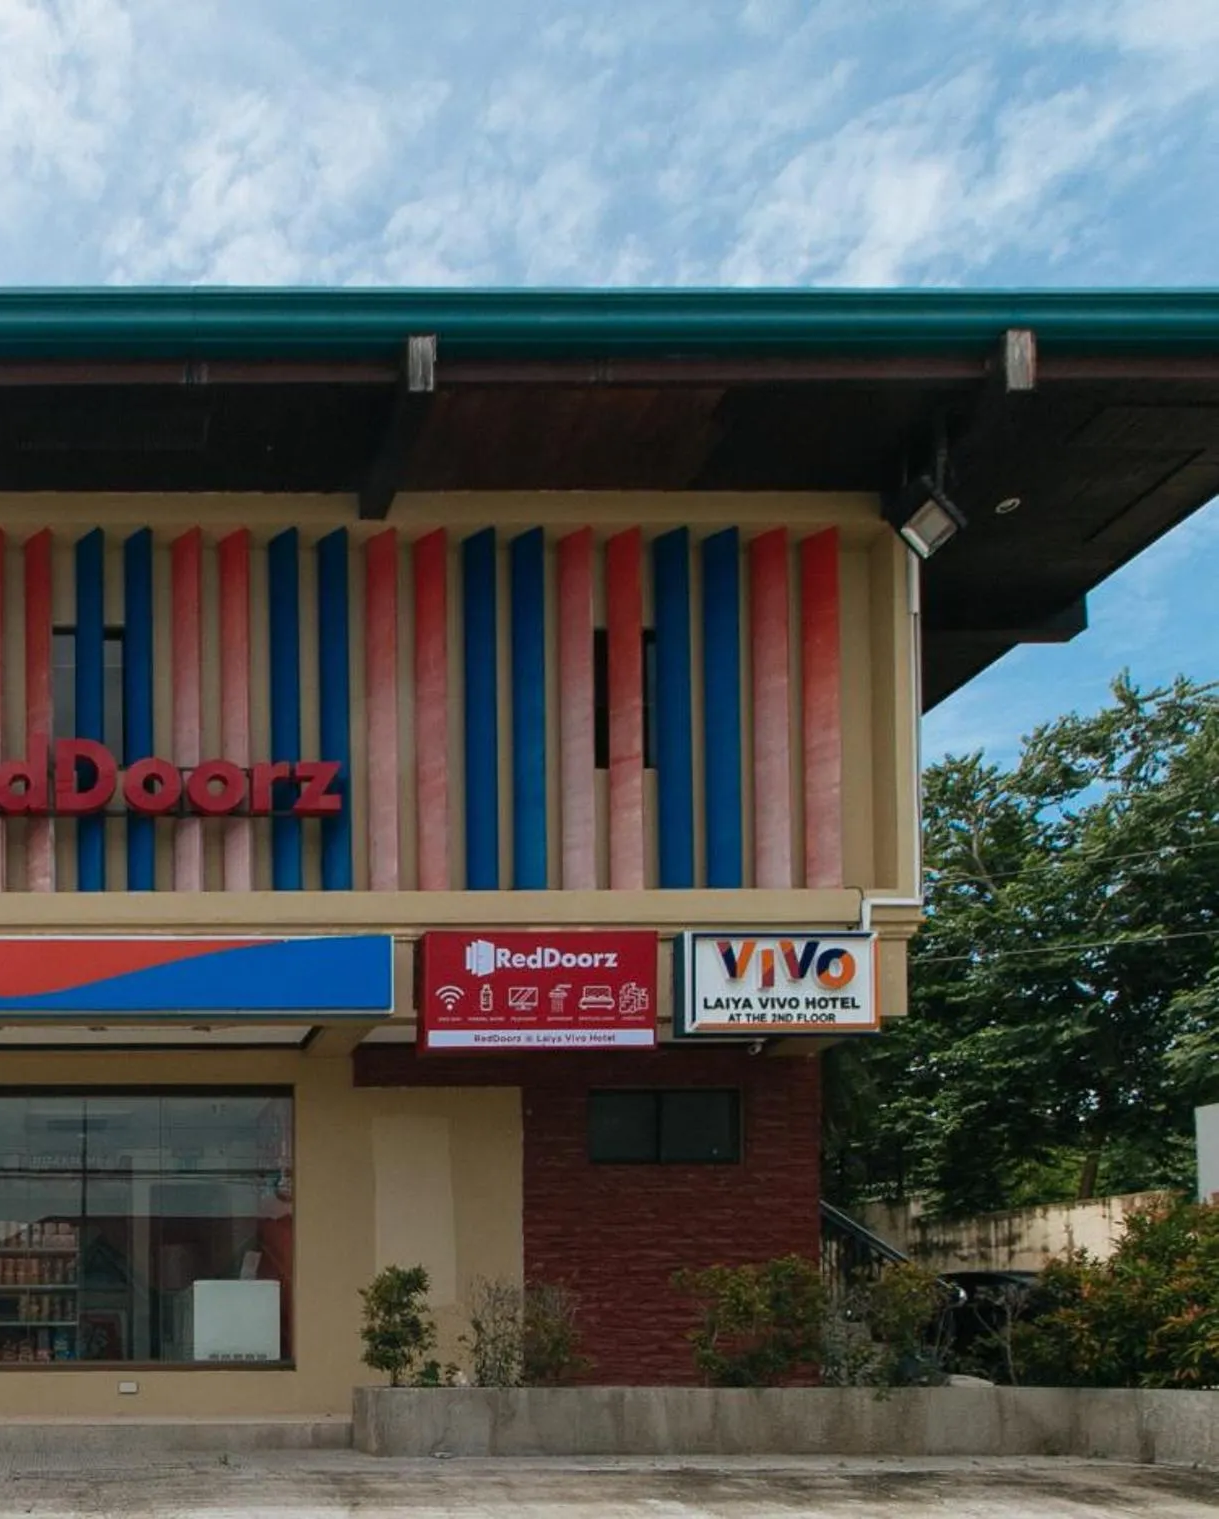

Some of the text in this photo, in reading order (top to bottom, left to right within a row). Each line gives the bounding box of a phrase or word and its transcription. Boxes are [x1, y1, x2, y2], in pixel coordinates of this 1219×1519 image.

[496, 946, 618, 969] RedDoorz
[703, 997, 861, 1010] LAIYA VIVO HOTEL
[728, 1013, 836, 1023] AT THE 2ND FLOOR
[565, 1033, 587, 1043] Vivo
[589, 1033, 616, 1043] Hotel
